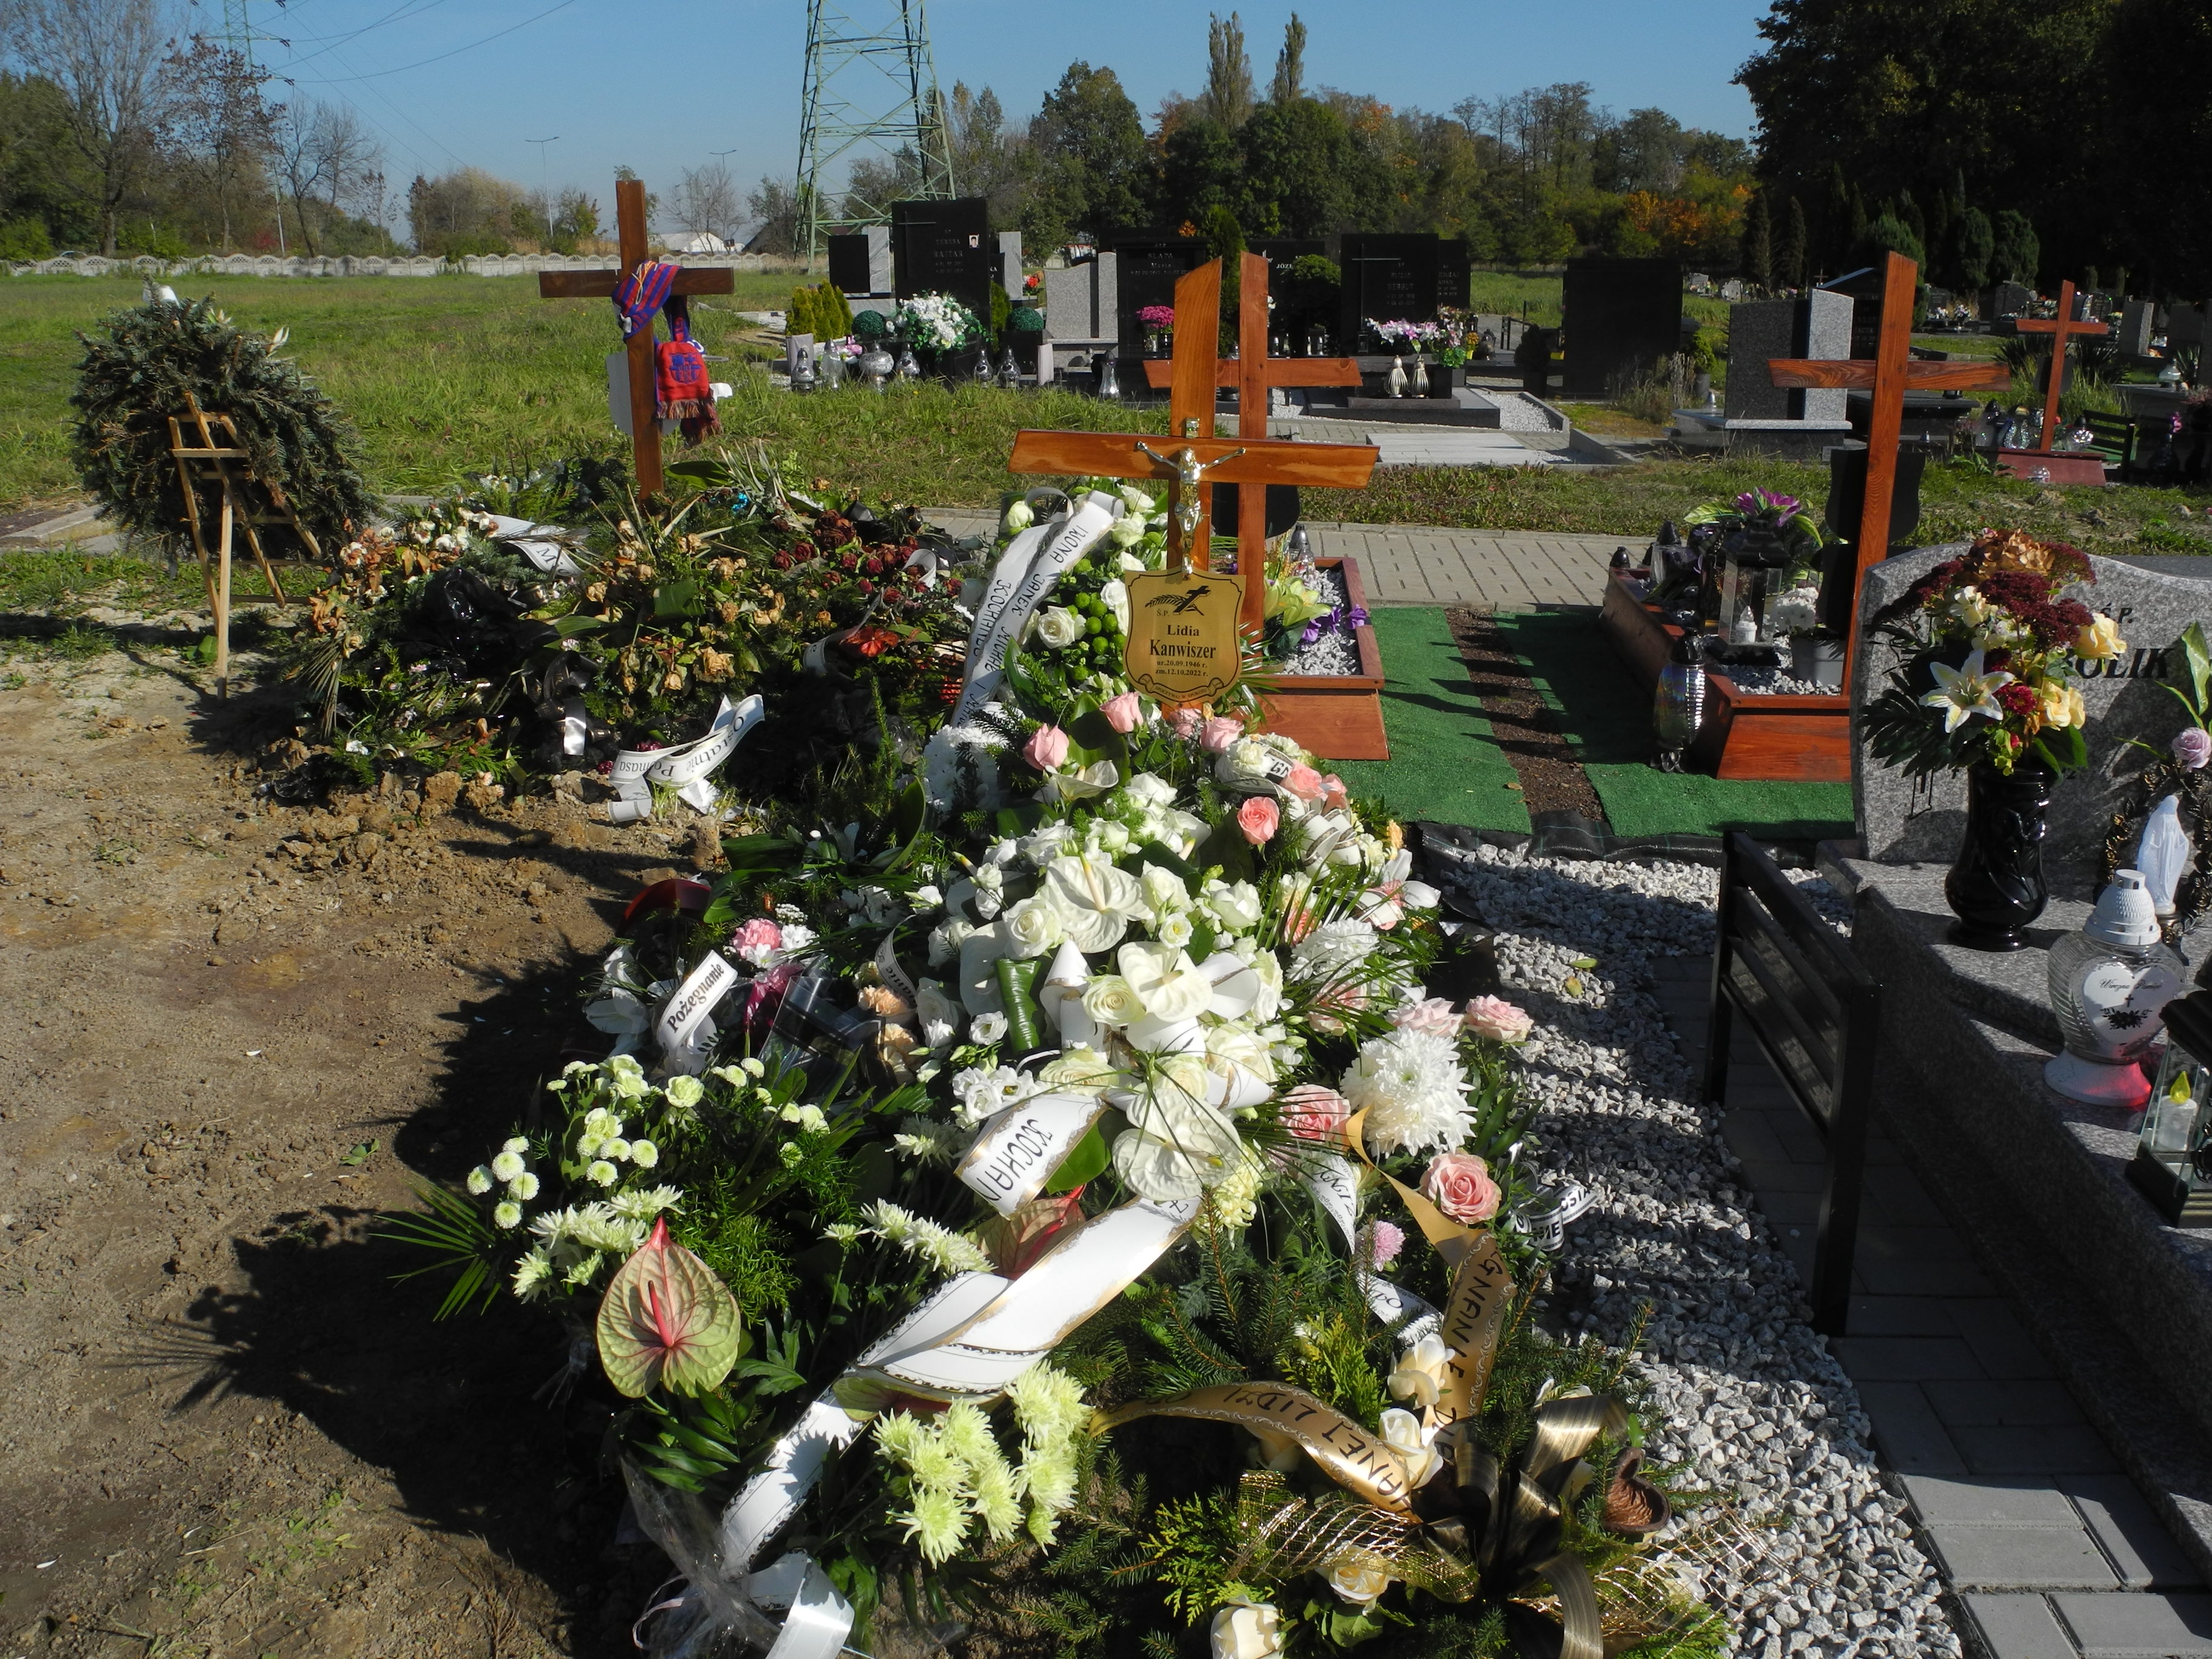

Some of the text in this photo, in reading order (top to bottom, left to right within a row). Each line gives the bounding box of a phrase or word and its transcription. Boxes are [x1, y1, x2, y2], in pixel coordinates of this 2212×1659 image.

[1011, 574, 1045, 617] JANEK
[1156, 608, 1170, 617] Ś.P.
[1167, 625, 1200, 637] Lidia
[1149, 639, 1216, 659] Kanwiszer
[2066, 648, 2174, 679] OLIK
[686, 716, 743, 773] Ostatnie
[666, 962, 725, 1034] Pożegnanie
